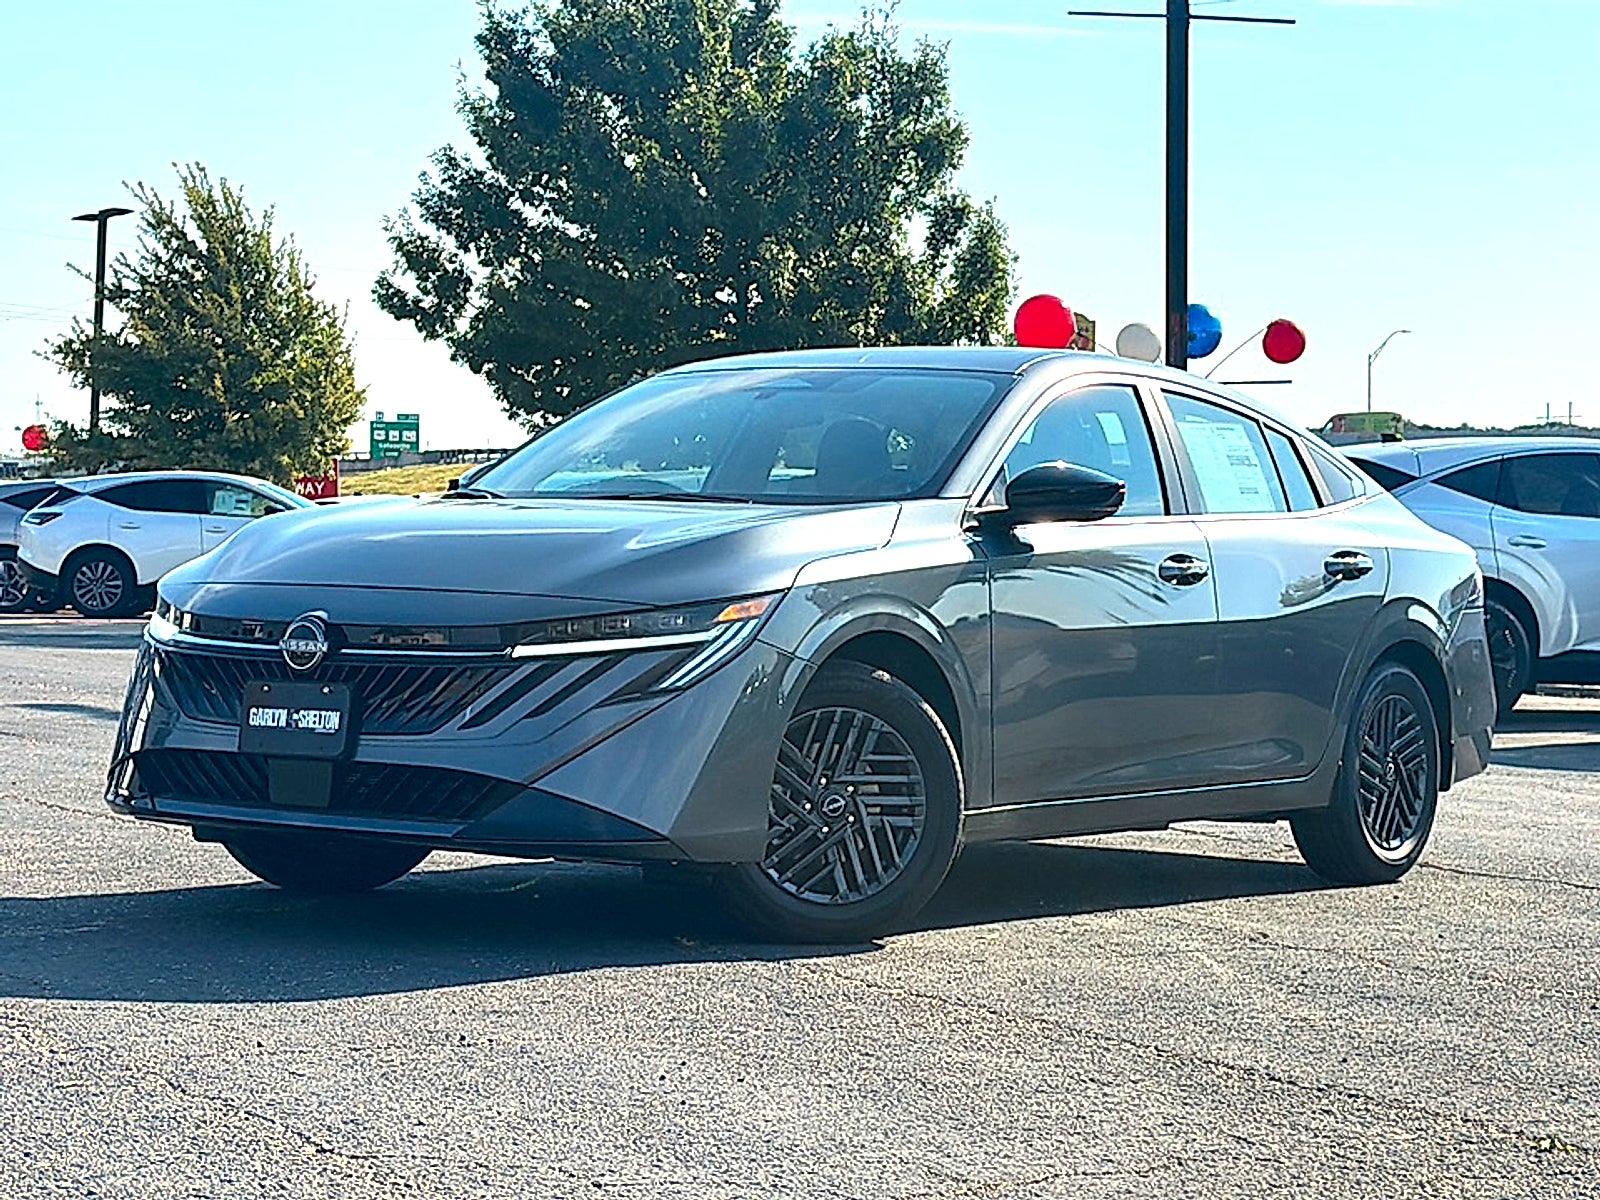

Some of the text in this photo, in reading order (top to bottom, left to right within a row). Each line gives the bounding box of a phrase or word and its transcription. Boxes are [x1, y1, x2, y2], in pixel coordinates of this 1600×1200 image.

[279, 639, 328, 652] NISSAN
[249, 707, 341, 730] GARLYN SHELTON
